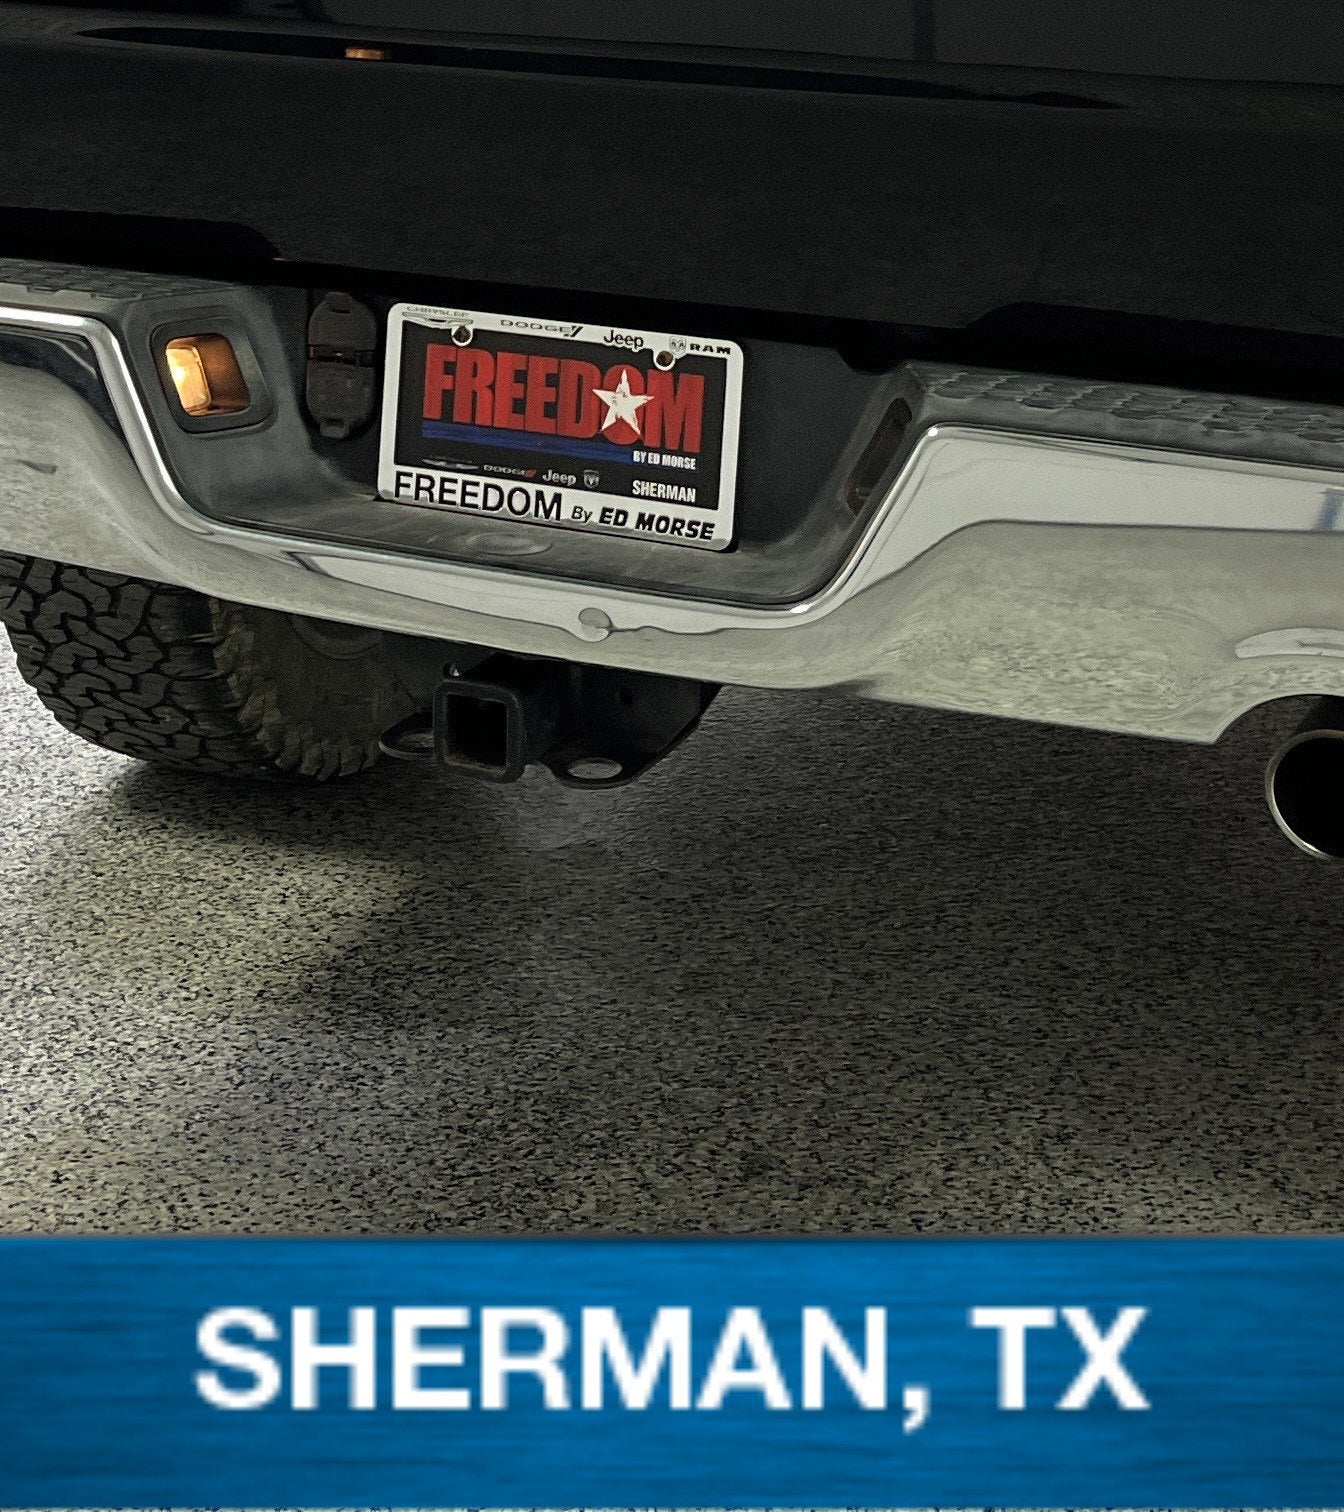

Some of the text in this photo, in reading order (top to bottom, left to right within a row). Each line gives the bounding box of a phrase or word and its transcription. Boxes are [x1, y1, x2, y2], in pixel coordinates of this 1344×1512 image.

[500, 319, 572, 334] DODGE
[603, 329, 645, 348] Jeep
[689, 342, 732, 355] RAM
[422, 342, 705, 454] FREEDOM
[633, 450, 696, 470] BY ED MORSE
[542, 469, 577, 486] Jeep
[632, 480, 696, 503] SHERMAN
[394, 470, 716, 541] FREEDOM By ED MORSE
